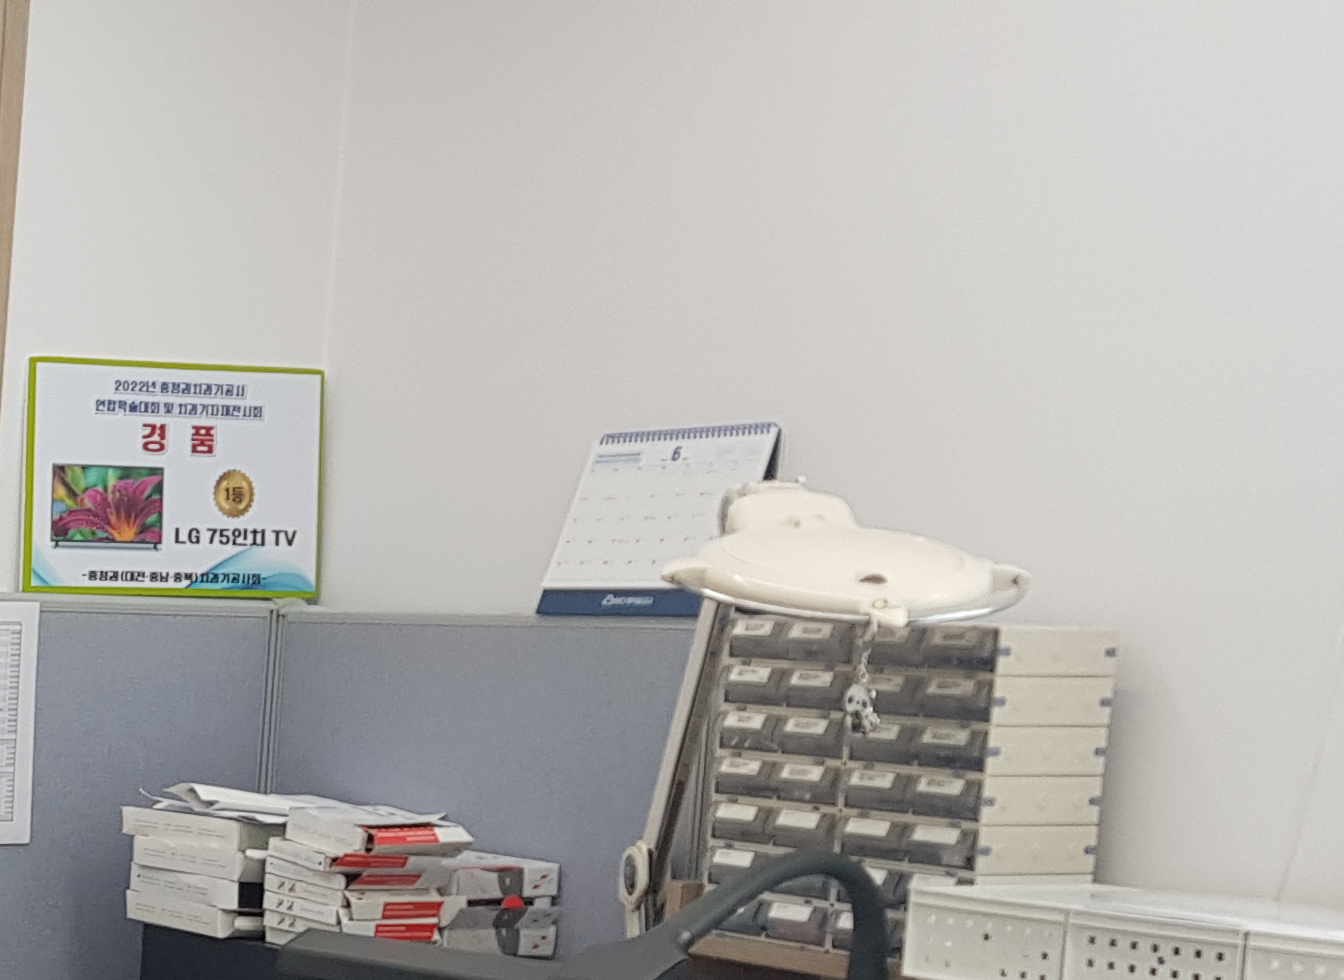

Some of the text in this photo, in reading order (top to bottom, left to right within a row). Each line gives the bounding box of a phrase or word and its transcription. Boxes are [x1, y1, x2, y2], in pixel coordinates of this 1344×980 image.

[114, 379, 157, 394] 2022년
[95, 398, 160, 414] 연합학술대회
[163, 401, 174, 415] 및
[141, 423, 215, 454] 경 품
[671, 446, 683, 461] 6
[224, 486, 245, 503] 1등
[174, 527, 298, 547] LG 75인치 TV
